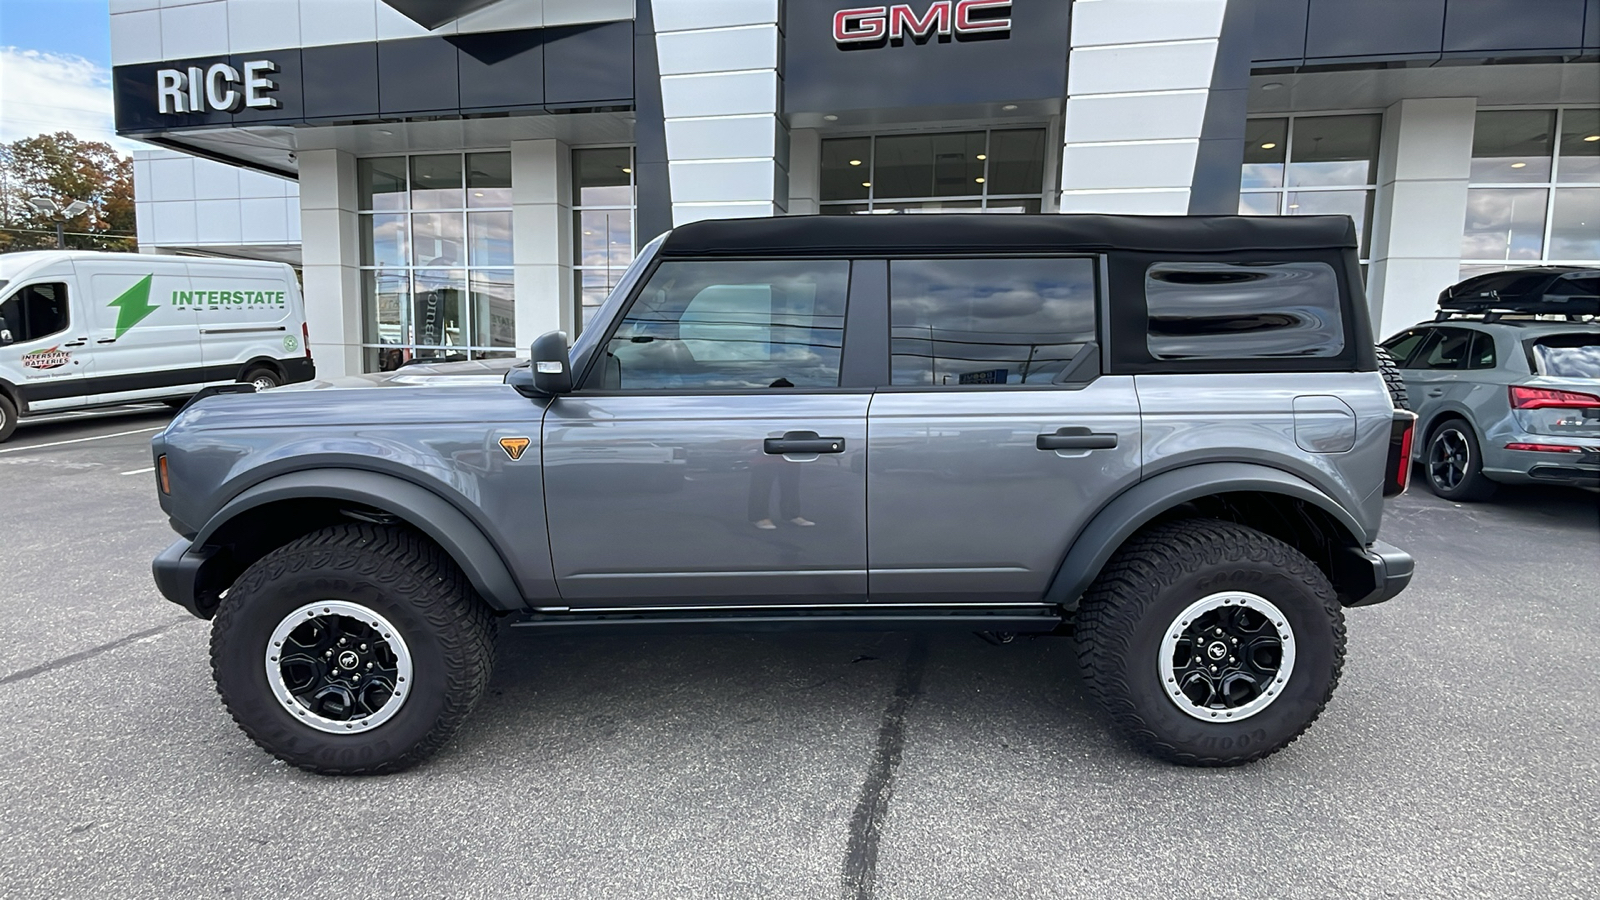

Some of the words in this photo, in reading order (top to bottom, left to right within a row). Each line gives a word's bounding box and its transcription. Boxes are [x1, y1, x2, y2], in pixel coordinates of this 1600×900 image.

[833, 0, 1012, 43] GMC
[157, 60, 277, 114] RICE
[171, 290, 285, 305] INTERSTATE
[22, 351, 70, 360] INTERSTATE
[25, 358, 69, 367] BATTERIES
